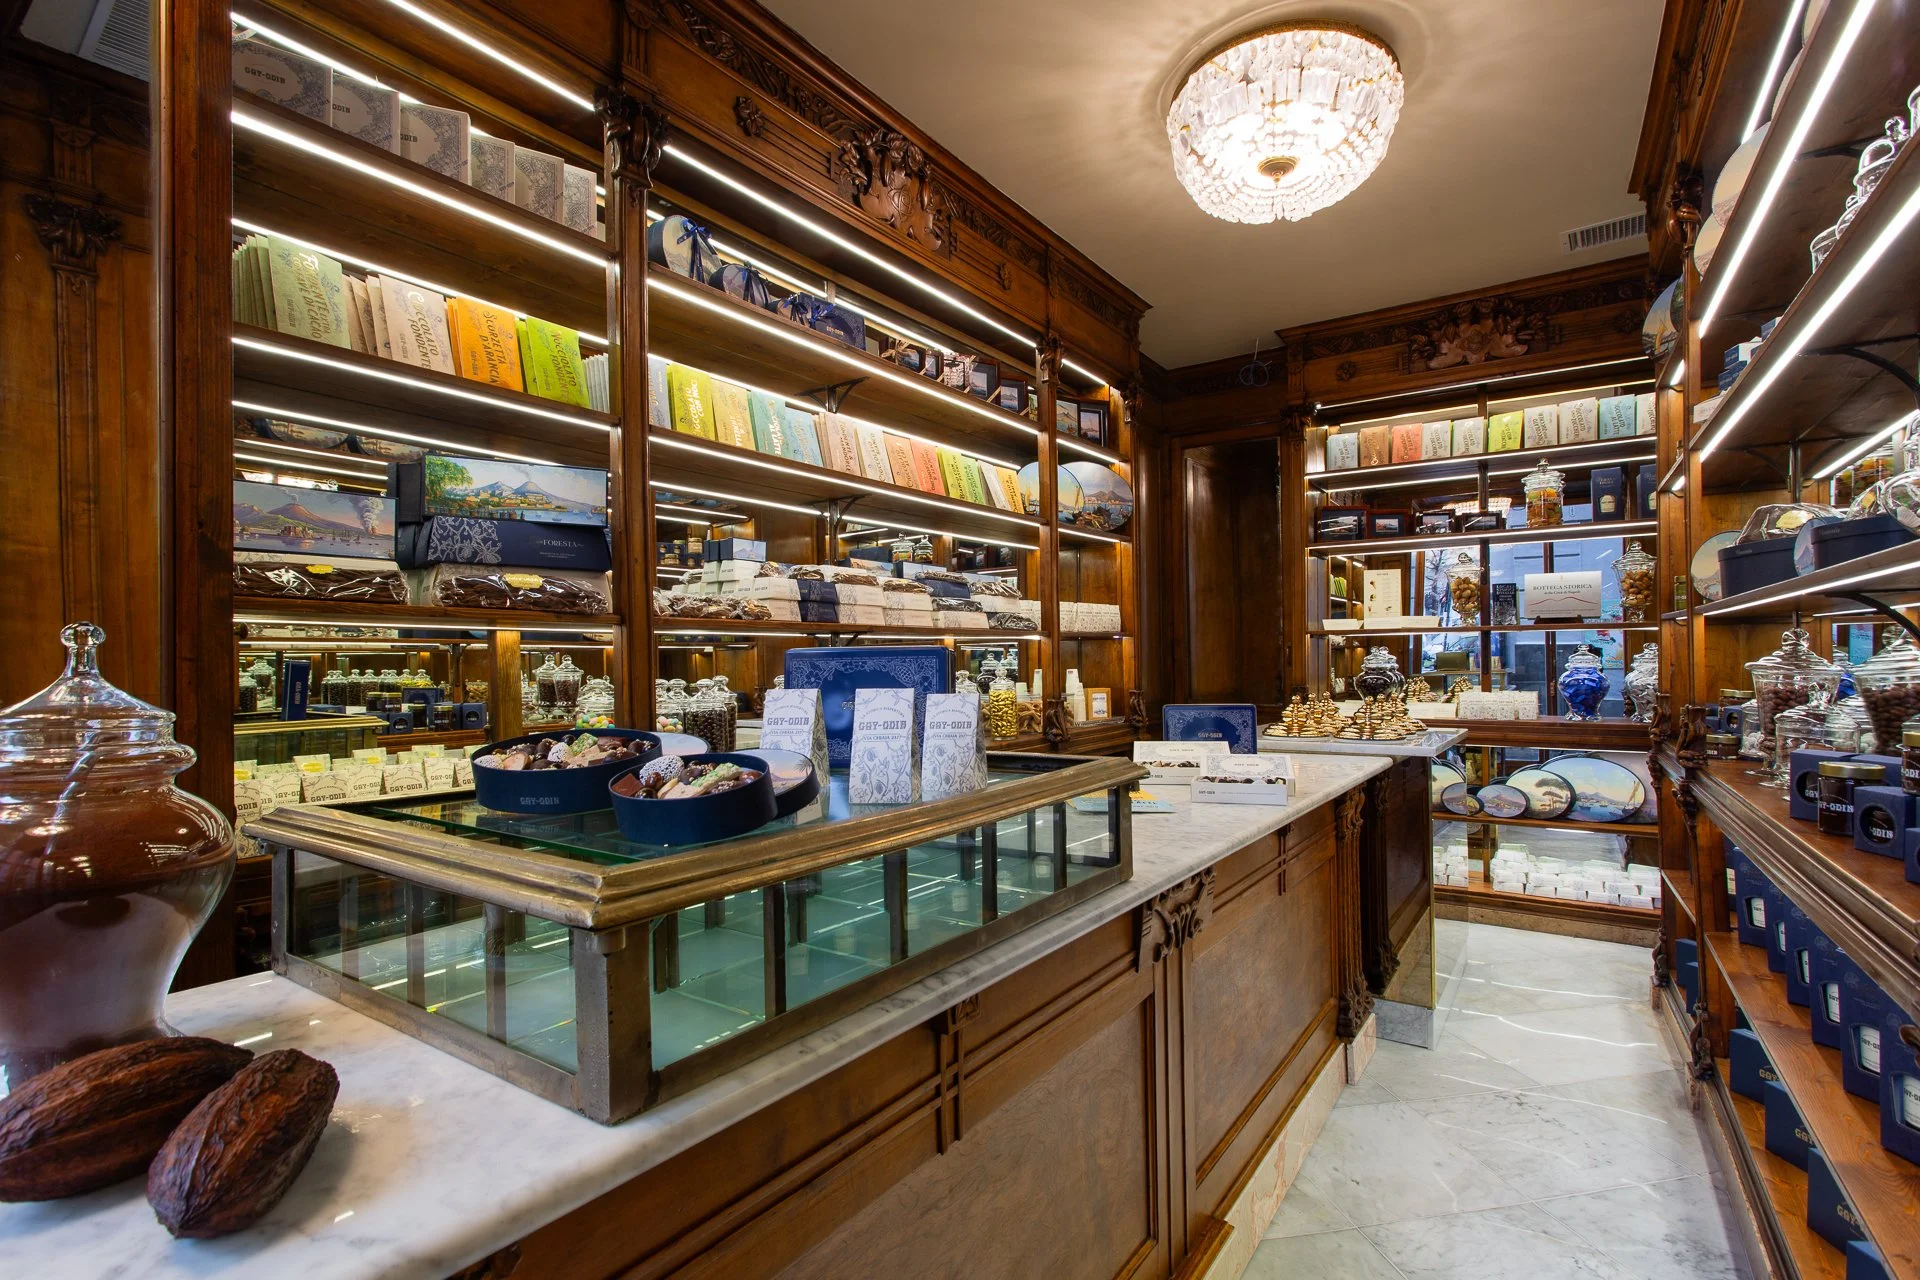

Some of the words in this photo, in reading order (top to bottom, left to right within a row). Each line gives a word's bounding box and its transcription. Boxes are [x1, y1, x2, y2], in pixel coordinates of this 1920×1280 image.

[244, 66, 286, 85] GAY-ODIN
[332, 103, 351, 114] ODIN
[400, 133, 418, 143] ODIN
[307, 308, 323, 339] CACAO
[407, 290, 439, 356] CIOCCOLATO
[407, 318, 432, 369] FONDENTE
[483, 311, 507, 364] SCORZETTA
[479, 334, 501, 384] D'ARANCIA
[551, 330, 577, 387] NOCCIOLATO
[685, 387, 702, 435] IOCCOLATO
[543, 539, 578, 548] FORESTA
[767, 717, 810, 726] GAY-ODIN
[858, 720, 907, 731] GAY-ODIN
[929, 721, 973, 730] GAY-ODIN
[1901, 767, 1920, 779] -ODI
[353, 781, 381, 791] GAY-OD
[389, 783, 424, 793] GAY-ODIN
[275, 790, 300, 799] AY-OD
[310, 792, 347, 803] GAY-ODIN
[519, 796, 560, 805] GAY-ODIN
[237, 802, 258, 811] ODIN
[1818, 801, 1854, 814] AY-ODIN
[1869, 827, 1894, 839] -ODIN
[1759, 1069, 1781, 1082] GAY-
[1837, 1205, 1864, 1231] GAY-
